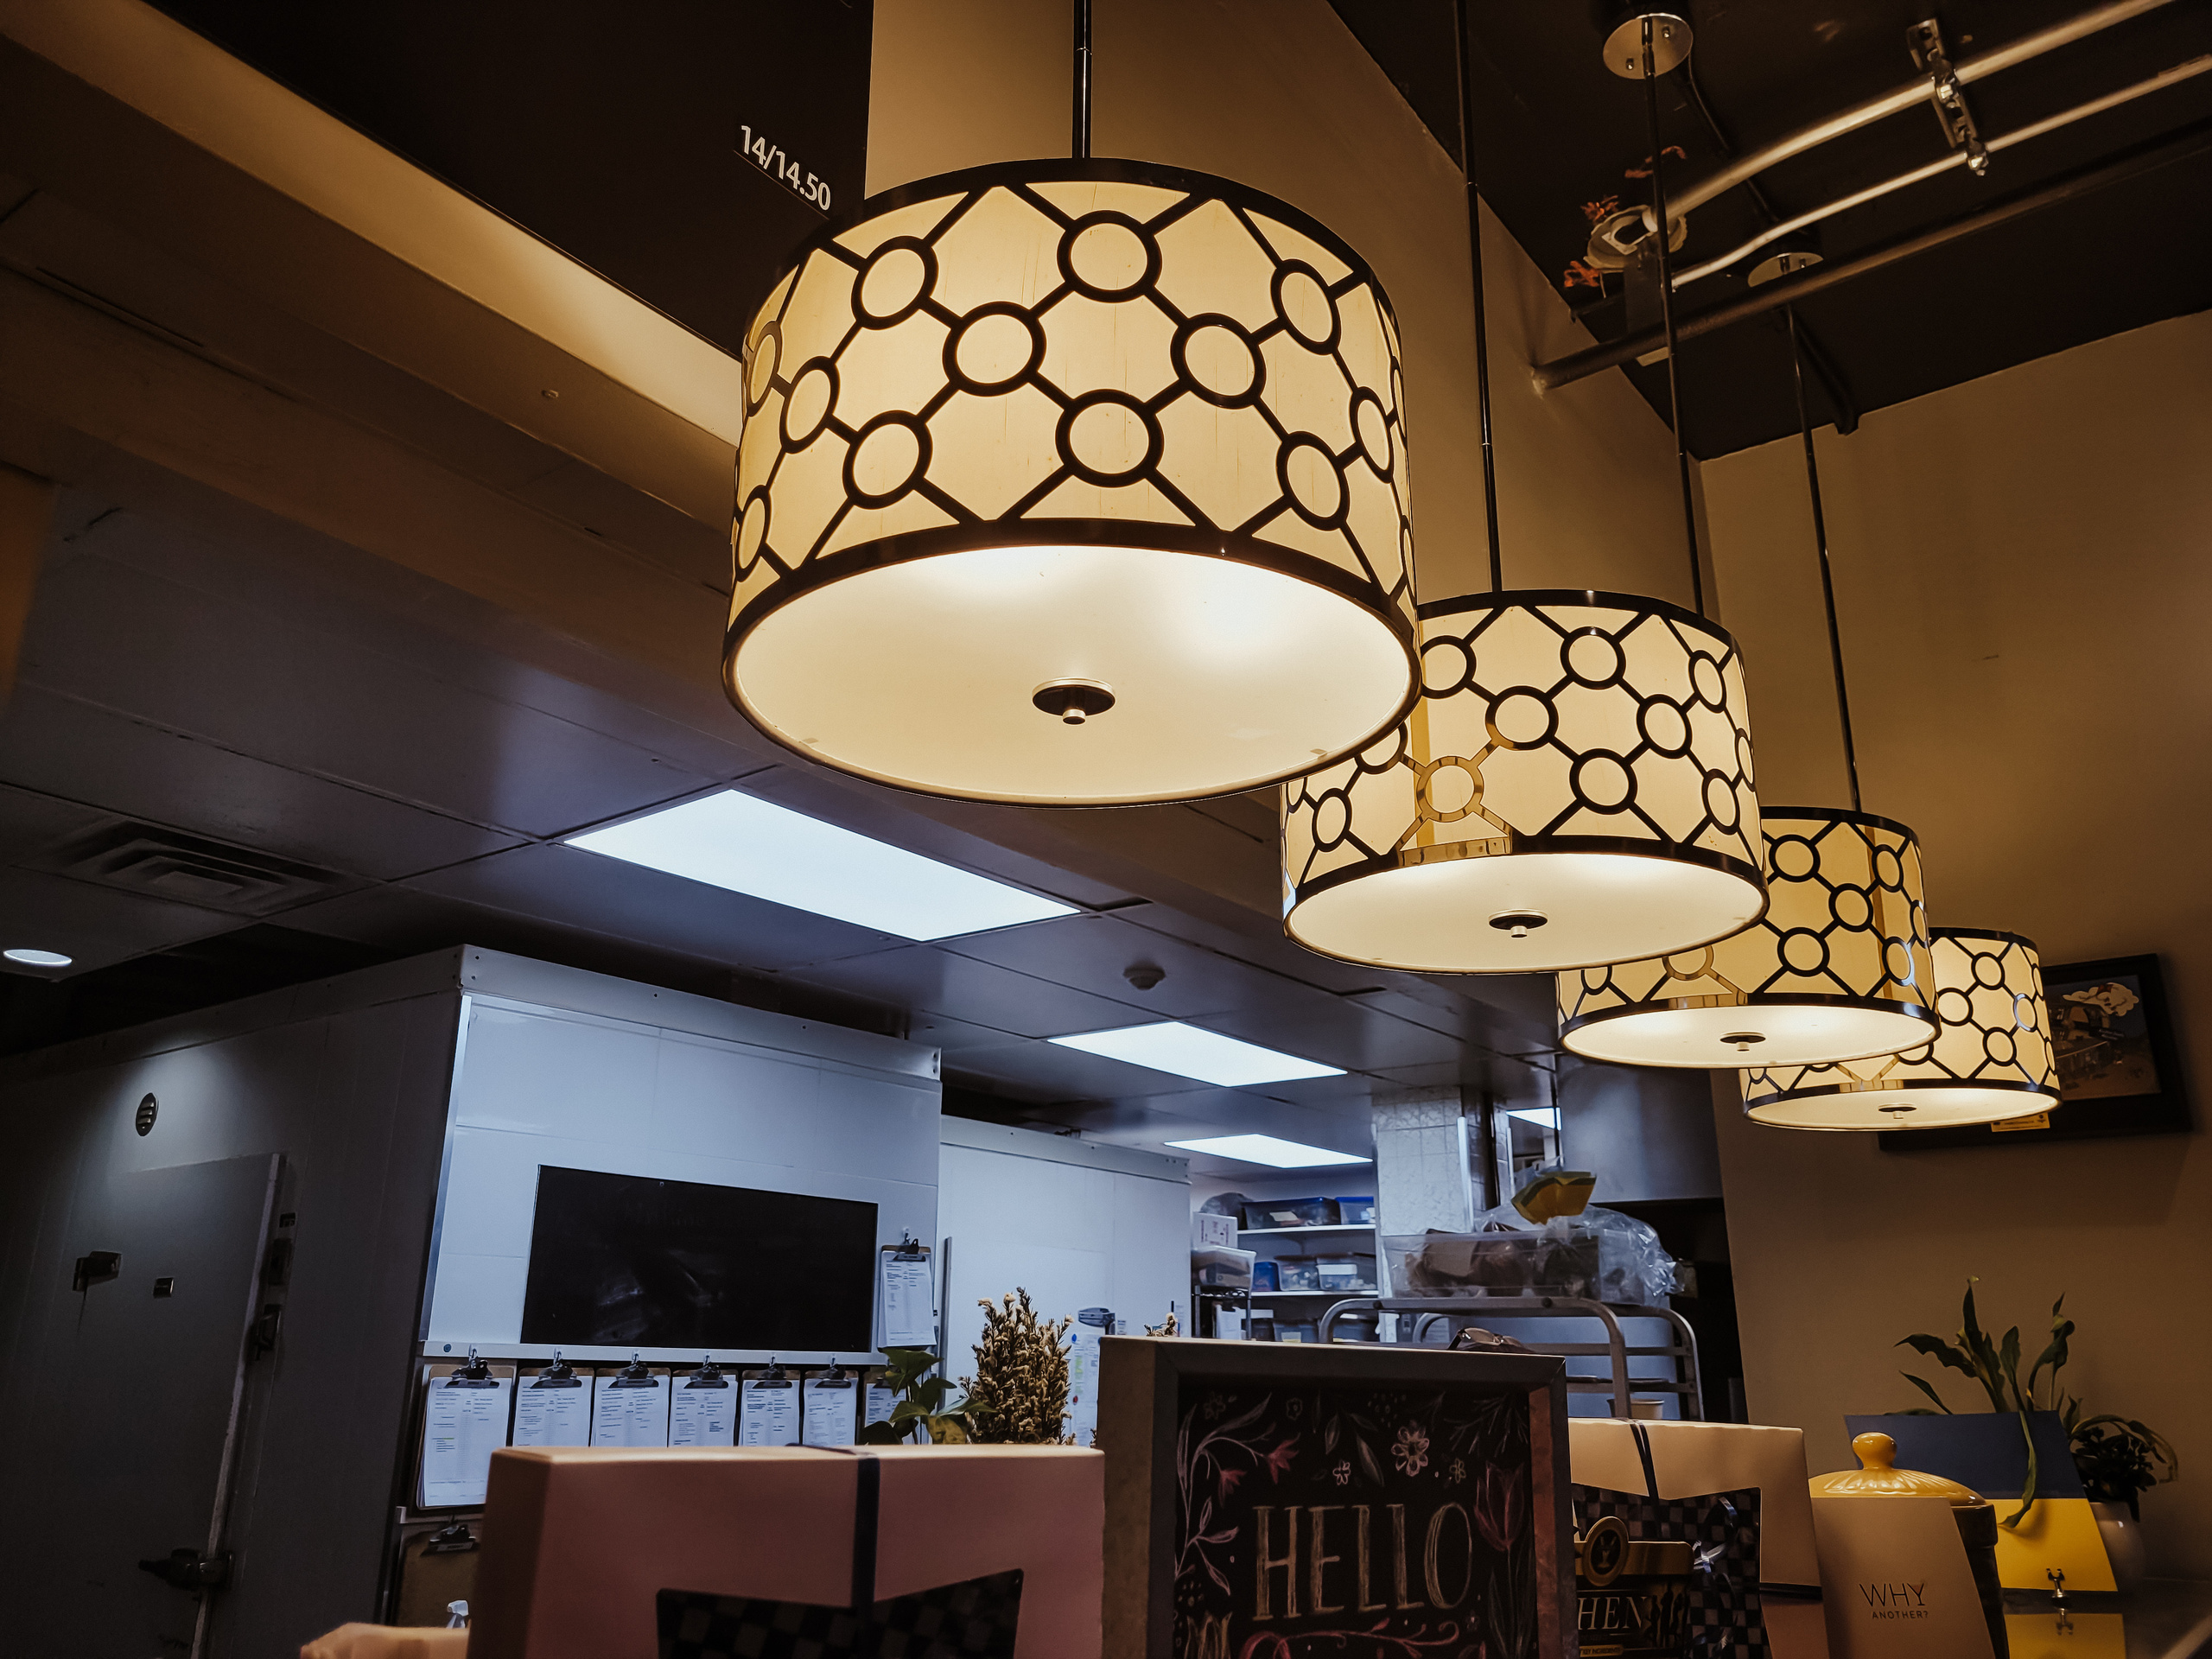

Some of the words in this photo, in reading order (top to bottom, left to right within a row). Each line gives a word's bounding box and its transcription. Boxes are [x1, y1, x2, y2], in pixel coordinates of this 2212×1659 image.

[741, 124, 831, 211] 14/14.50
[1252, 1502, 1472, 1621] HELLO
[1859, 1583, 1926, 1607] WHY
[1872, 1610, 1929, 1620] ANOTHER?
